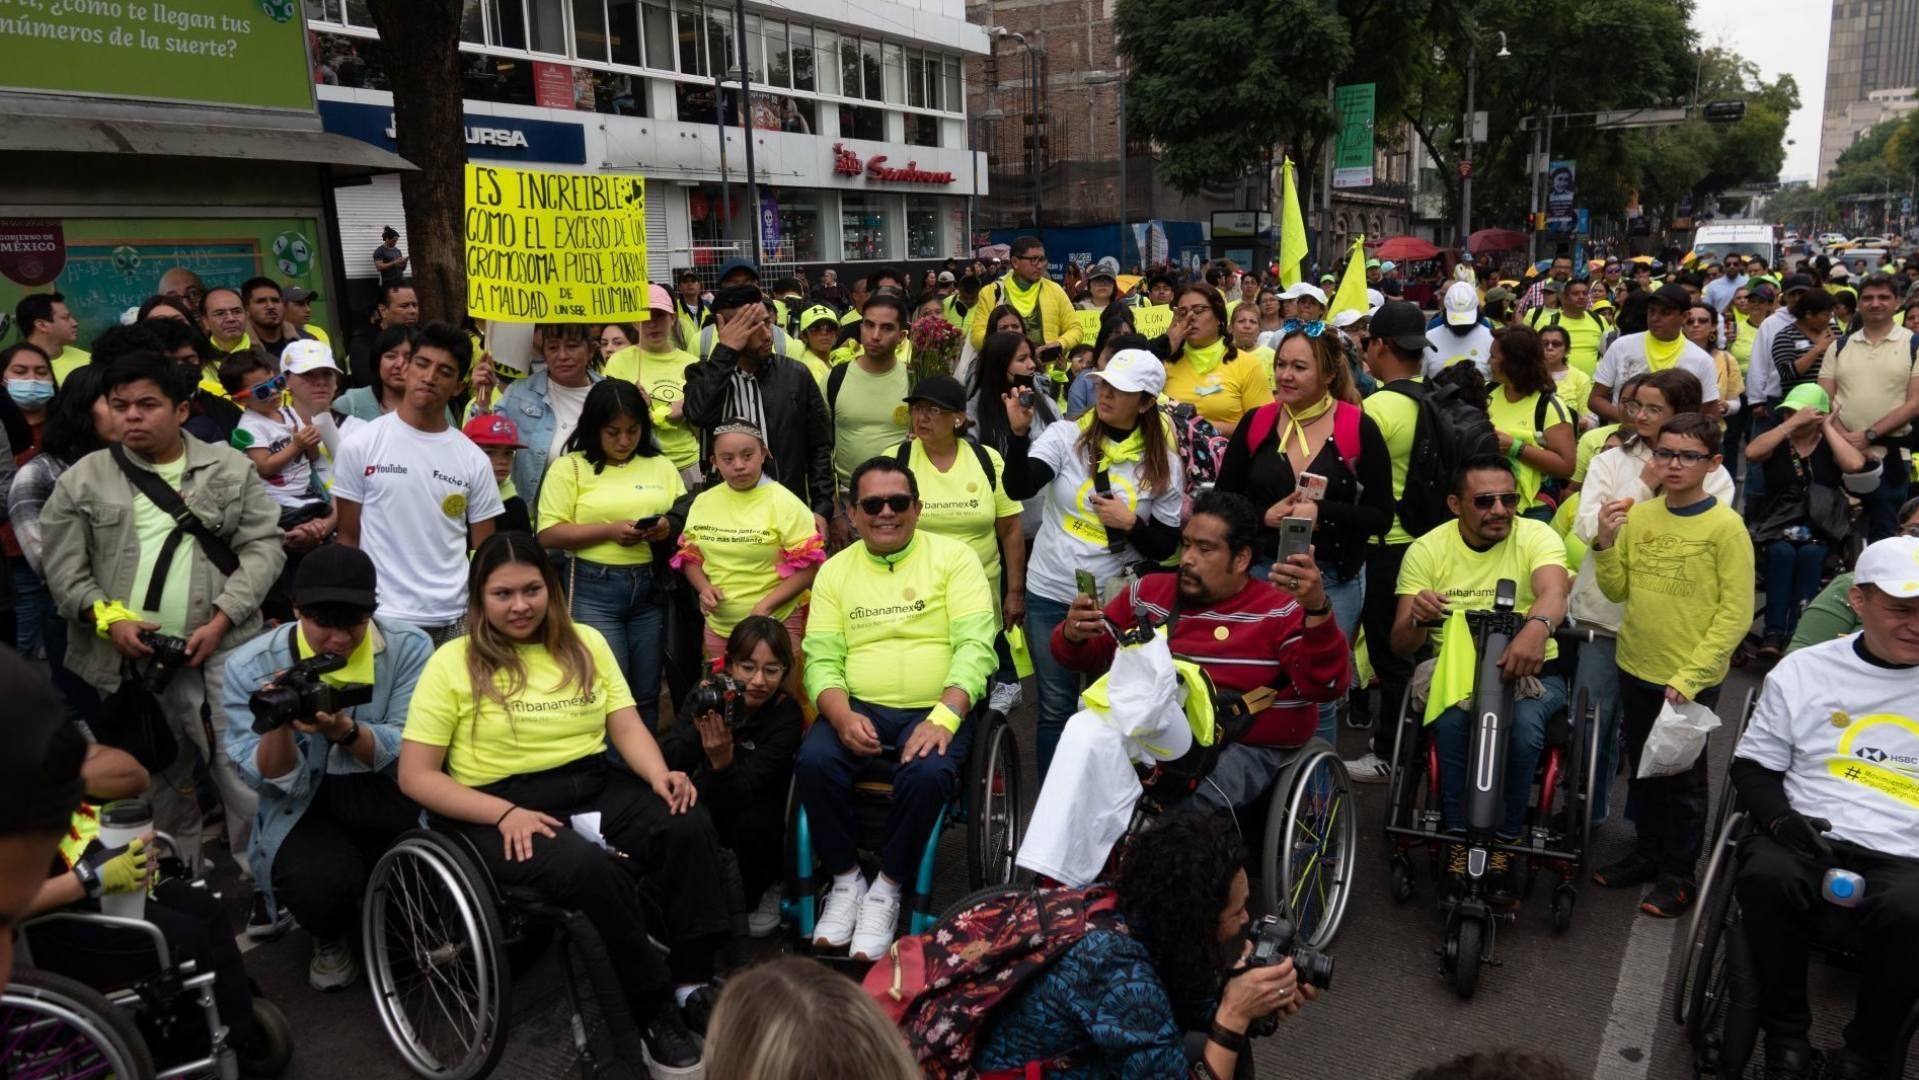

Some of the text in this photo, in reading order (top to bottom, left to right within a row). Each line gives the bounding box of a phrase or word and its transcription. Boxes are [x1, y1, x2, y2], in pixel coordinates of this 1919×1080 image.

[128, 3, 147, 21] te
[153, 3, 216, 31] llegan
[222, 15, 251, 34] tus
[0, 14, 238, 58] números de la suerte?
[476, 167, 623, 211] ES INCREIBLE
[466, 207, 645, 249] COMO EL EXCESO DE UN
[0, 240, 56, 252] MÉXICO
[467, 246, 559, 284] CROMOSOMA
[564, 252, 607, 284] PUEDE
[467, 278, 486, 312] LA
[490, 284, 549, 319] MALDAD
[560, 288, 573, 299] DE
[554, 305, 586, 316] UN SER
[377, 464, 408, 474] YouTube
[924, 502, 969, 510] banamex
[731, 536, 763, 544] brillante
[849, 606, 914, 620] citibanamex
[1890, 754, 1918, 765] HSBC
